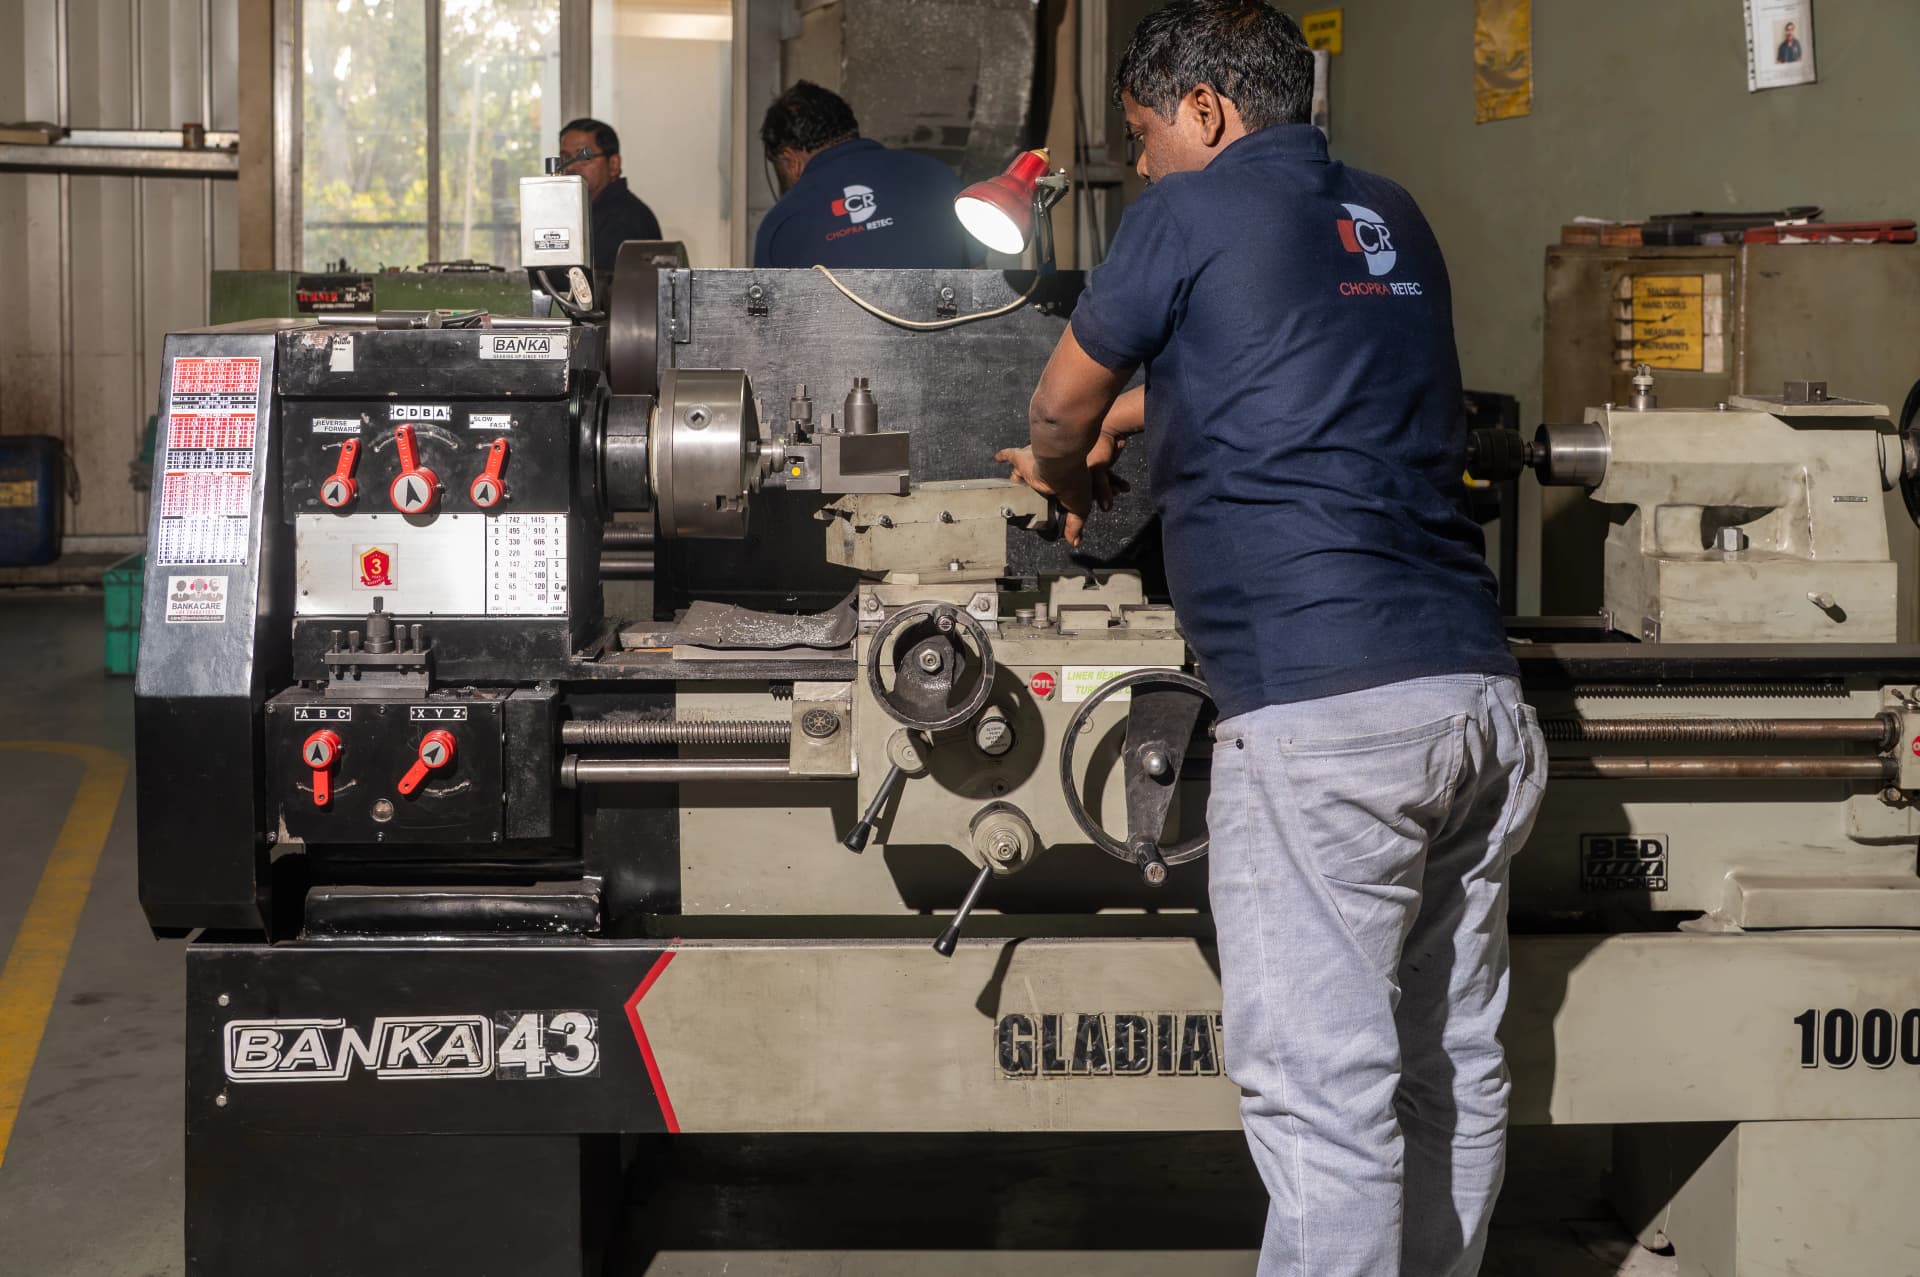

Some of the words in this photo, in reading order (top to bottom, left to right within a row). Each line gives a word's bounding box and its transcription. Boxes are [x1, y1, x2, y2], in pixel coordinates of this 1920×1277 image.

[845, 194, 876, 212] CR
[825, 225, 865, 240] CHOPRA
[866, 217, 894, 231] RETEC
[1355, 221, 1394, 252] CR
[1340, 282, 1390, 296] CHOPRA
[1389, 282, 1423, 296] RETEC
[1647, 287, 1681, 296] MACHINE
[1664, 301, 1687, 309] TOOLS
[494, 337, 550, 353] BANKA
[396, 408, 405, 417] C
[409, 408, 418, 417] D
[423, 408, 431, 417] B
[436, 408, 444, 417] A
[371, 558, 382, 574] 3
[1032, 680, 1052, 688] OIL
[1067, 671, 1093, 681] LINER
[300, 709, 309, 718] A
[319, 709, 327, 718] B
[337, 709, 346, 718] C
[417, 709, 425, 718] X
[435, 709, 443, 718] Y
[453, 709, 461, 718] Z
[1590, 838, 1663, 859] BED
[225, 1016, 493, 1082] BANKA
[499, 1012, 599, 1078] 43
[999, 1013, 1222, 1076] GLADIA
[1793, 1008, 1920, 1070] 1000
